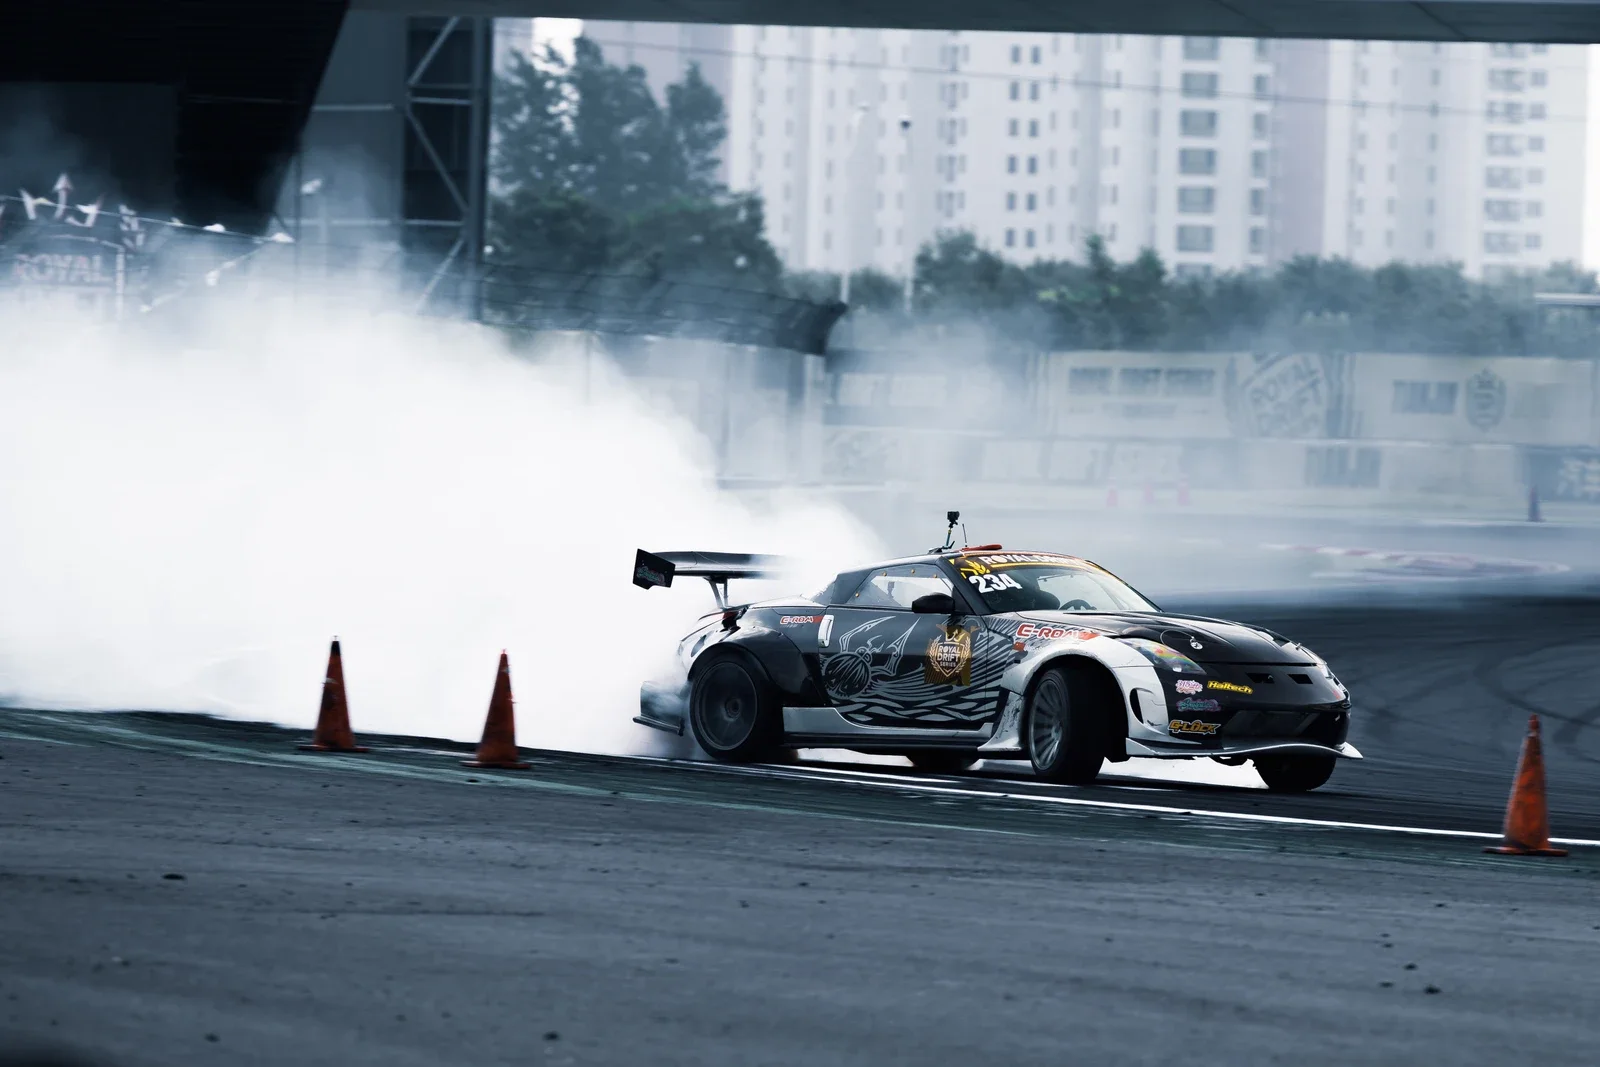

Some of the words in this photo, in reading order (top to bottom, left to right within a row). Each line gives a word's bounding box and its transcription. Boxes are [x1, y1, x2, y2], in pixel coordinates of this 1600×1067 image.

[13, 253, 113, 282] ROYAL
[979, 554, 1038, 565] ROYAL
[968, 573, 1023, 594] 234
[938, 645, 961, 654] ROYAL
[937, 653, 960, 662] DRIFT
[1207, 681, 1253, 694] Haltech
